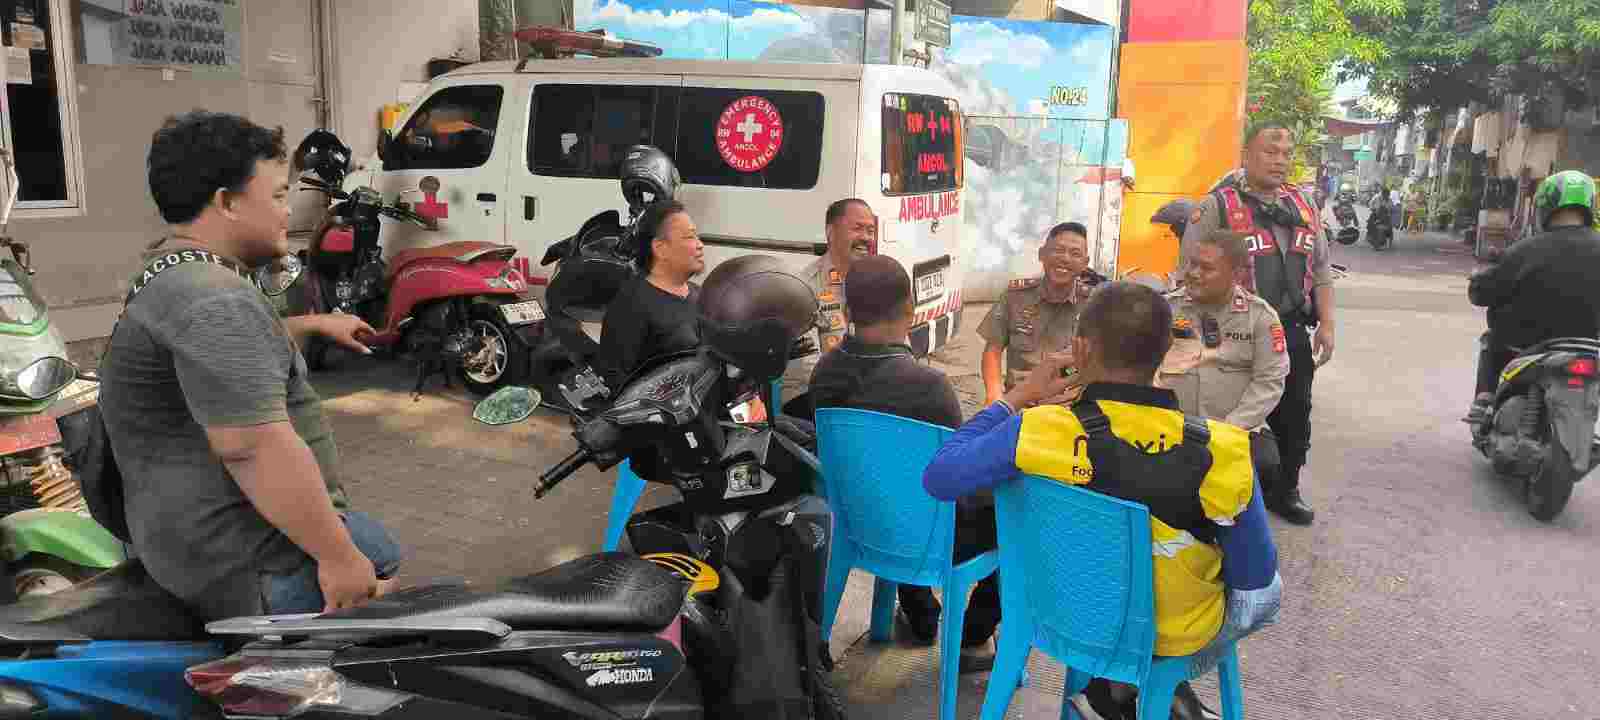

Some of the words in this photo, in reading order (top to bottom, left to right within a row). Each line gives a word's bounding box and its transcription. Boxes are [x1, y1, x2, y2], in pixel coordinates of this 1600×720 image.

[720, 98, 781, 127] EMERGENCY
[719, 140, 778, 169] AMBULANCE
[899, 191, 960, 222] AMBULANCE
[133, 251, 222, 294] LACOSTE
[614, 668, 653, 684] HONDA
